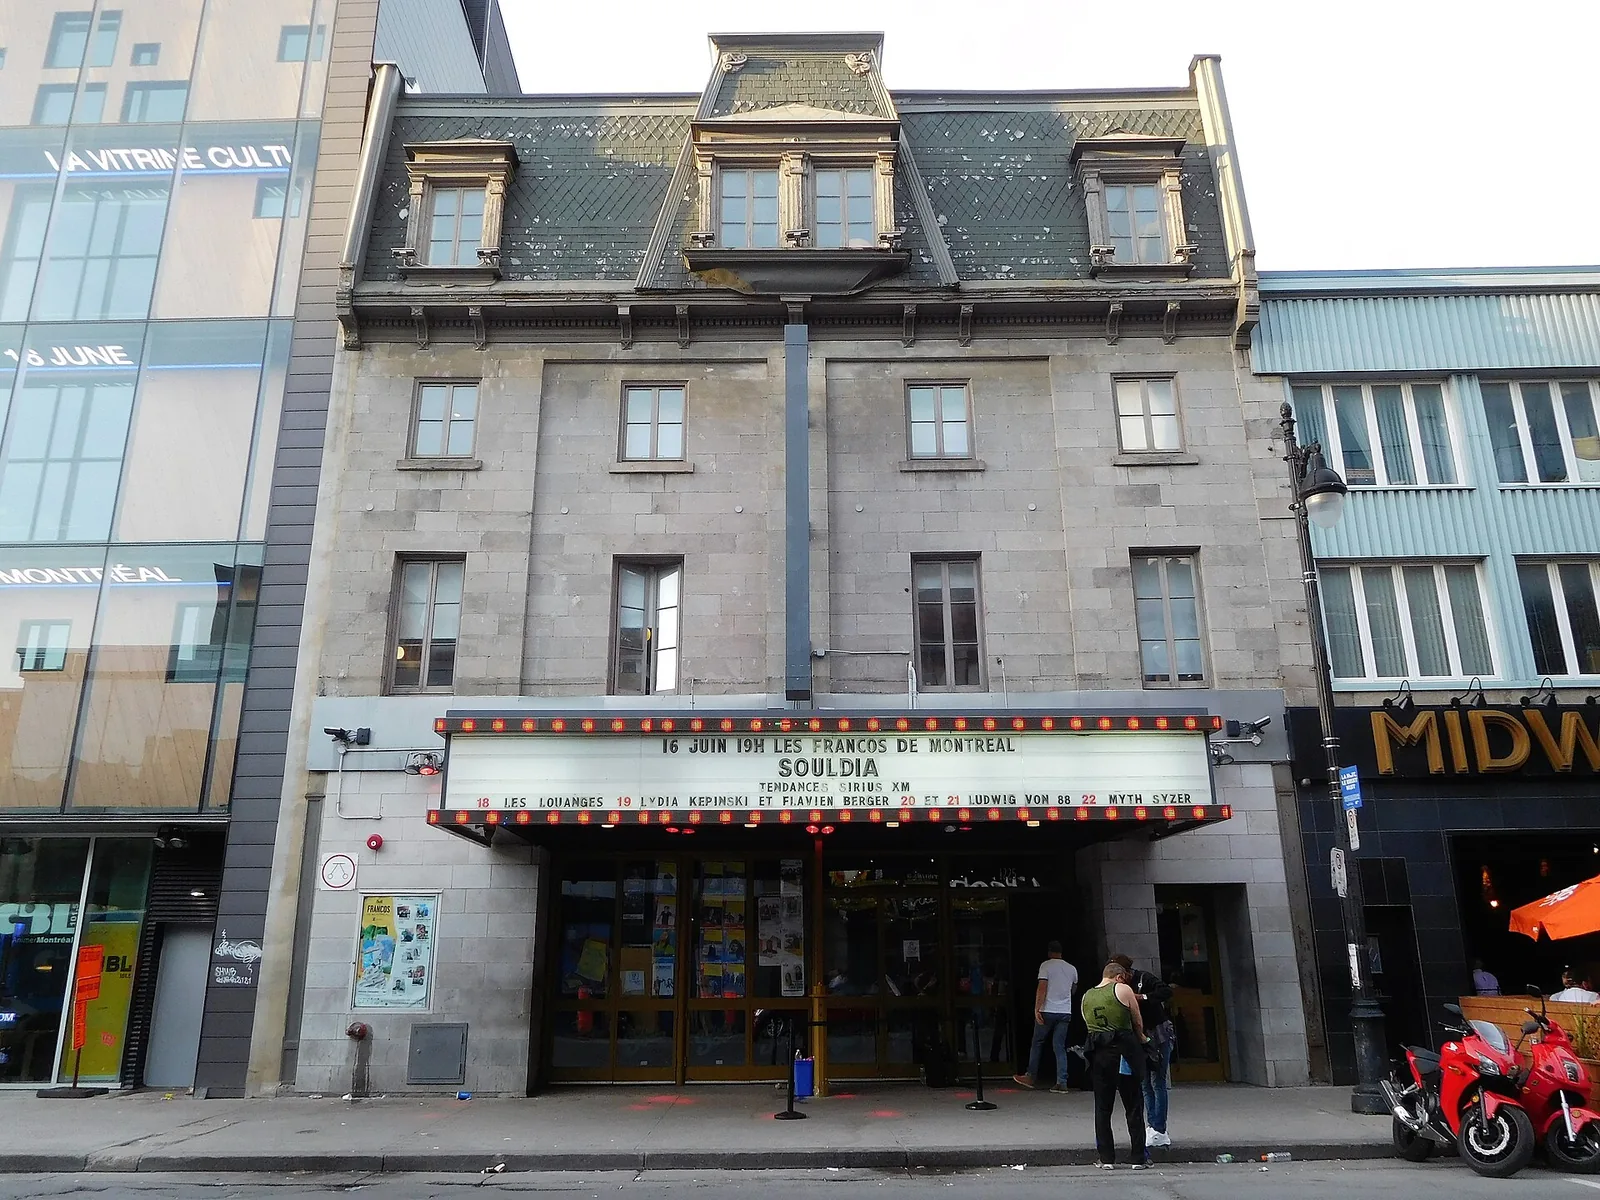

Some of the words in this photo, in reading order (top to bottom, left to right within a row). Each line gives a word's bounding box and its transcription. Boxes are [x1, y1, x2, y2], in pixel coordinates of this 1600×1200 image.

[86, 147, 206, 171] VITRINE
[50, 345, 134, 366] JUNE
[662, 738, 679, 754] 16
[737, 738, 764, 754] 19H
[774, 738, 802, 754] LES
[813, 738, 887, 754] FRANCOS
[896, 738, 918, 753] DE
[929, 737, 1015, 753] MONTREAL
[778, 757, 879, 778] SOULDIA
[759, 782, 828, 793] TENDANCES
[838, 782, 883, 792] SIRIUS
[892, 782, 910, 792] XM
[476, 797, 490, 808] 18
[504, 797, 527, 808] LES
[539, 796, 604, 808] LOUANGES
[617, 796, 631, 807] 19
[640, 796, 679, 807] LYDIA
[689, 796, 748, 807] KEPINSKI
[759, 796, 773, 807] ET
[782, 796, 834, 807] FLAVIEN
[843, 795, 889, 806] BERGER
[900, 795, 916, 806] 20
[924, 795, 939, 806] ET
[947, 795, 960, 805] 21
[969, 795, 1017, 805] LUDWIG
[1025, 794, 1049, 805] VON
[1057, 795, 1071, 805] 88
[1081, 794, 1097, 805] 22
[1109, 794, 1143, 805] MYTH
[1152, 793, 1192, 804] SYZER
[1092, 1006, 1109, 1028] 5
